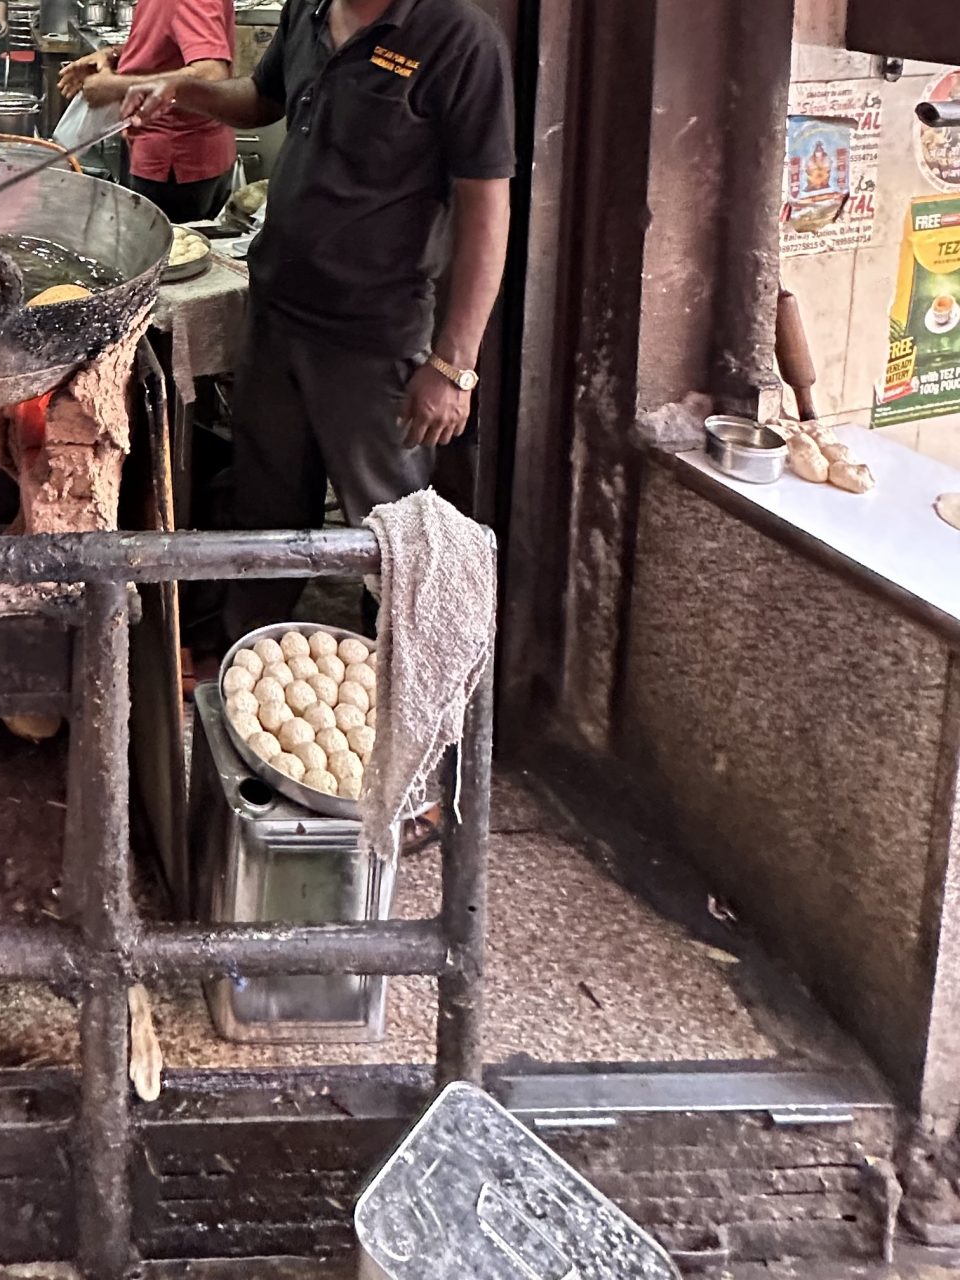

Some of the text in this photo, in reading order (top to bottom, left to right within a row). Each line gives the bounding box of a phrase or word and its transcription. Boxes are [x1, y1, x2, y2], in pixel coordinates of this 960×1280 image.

[915, 214, 941, 230] FREE
[938, 240, 960, 256] TEZ
[940, 368, 955, 380] TEZ
[920, 383, 939, 395] 100g
